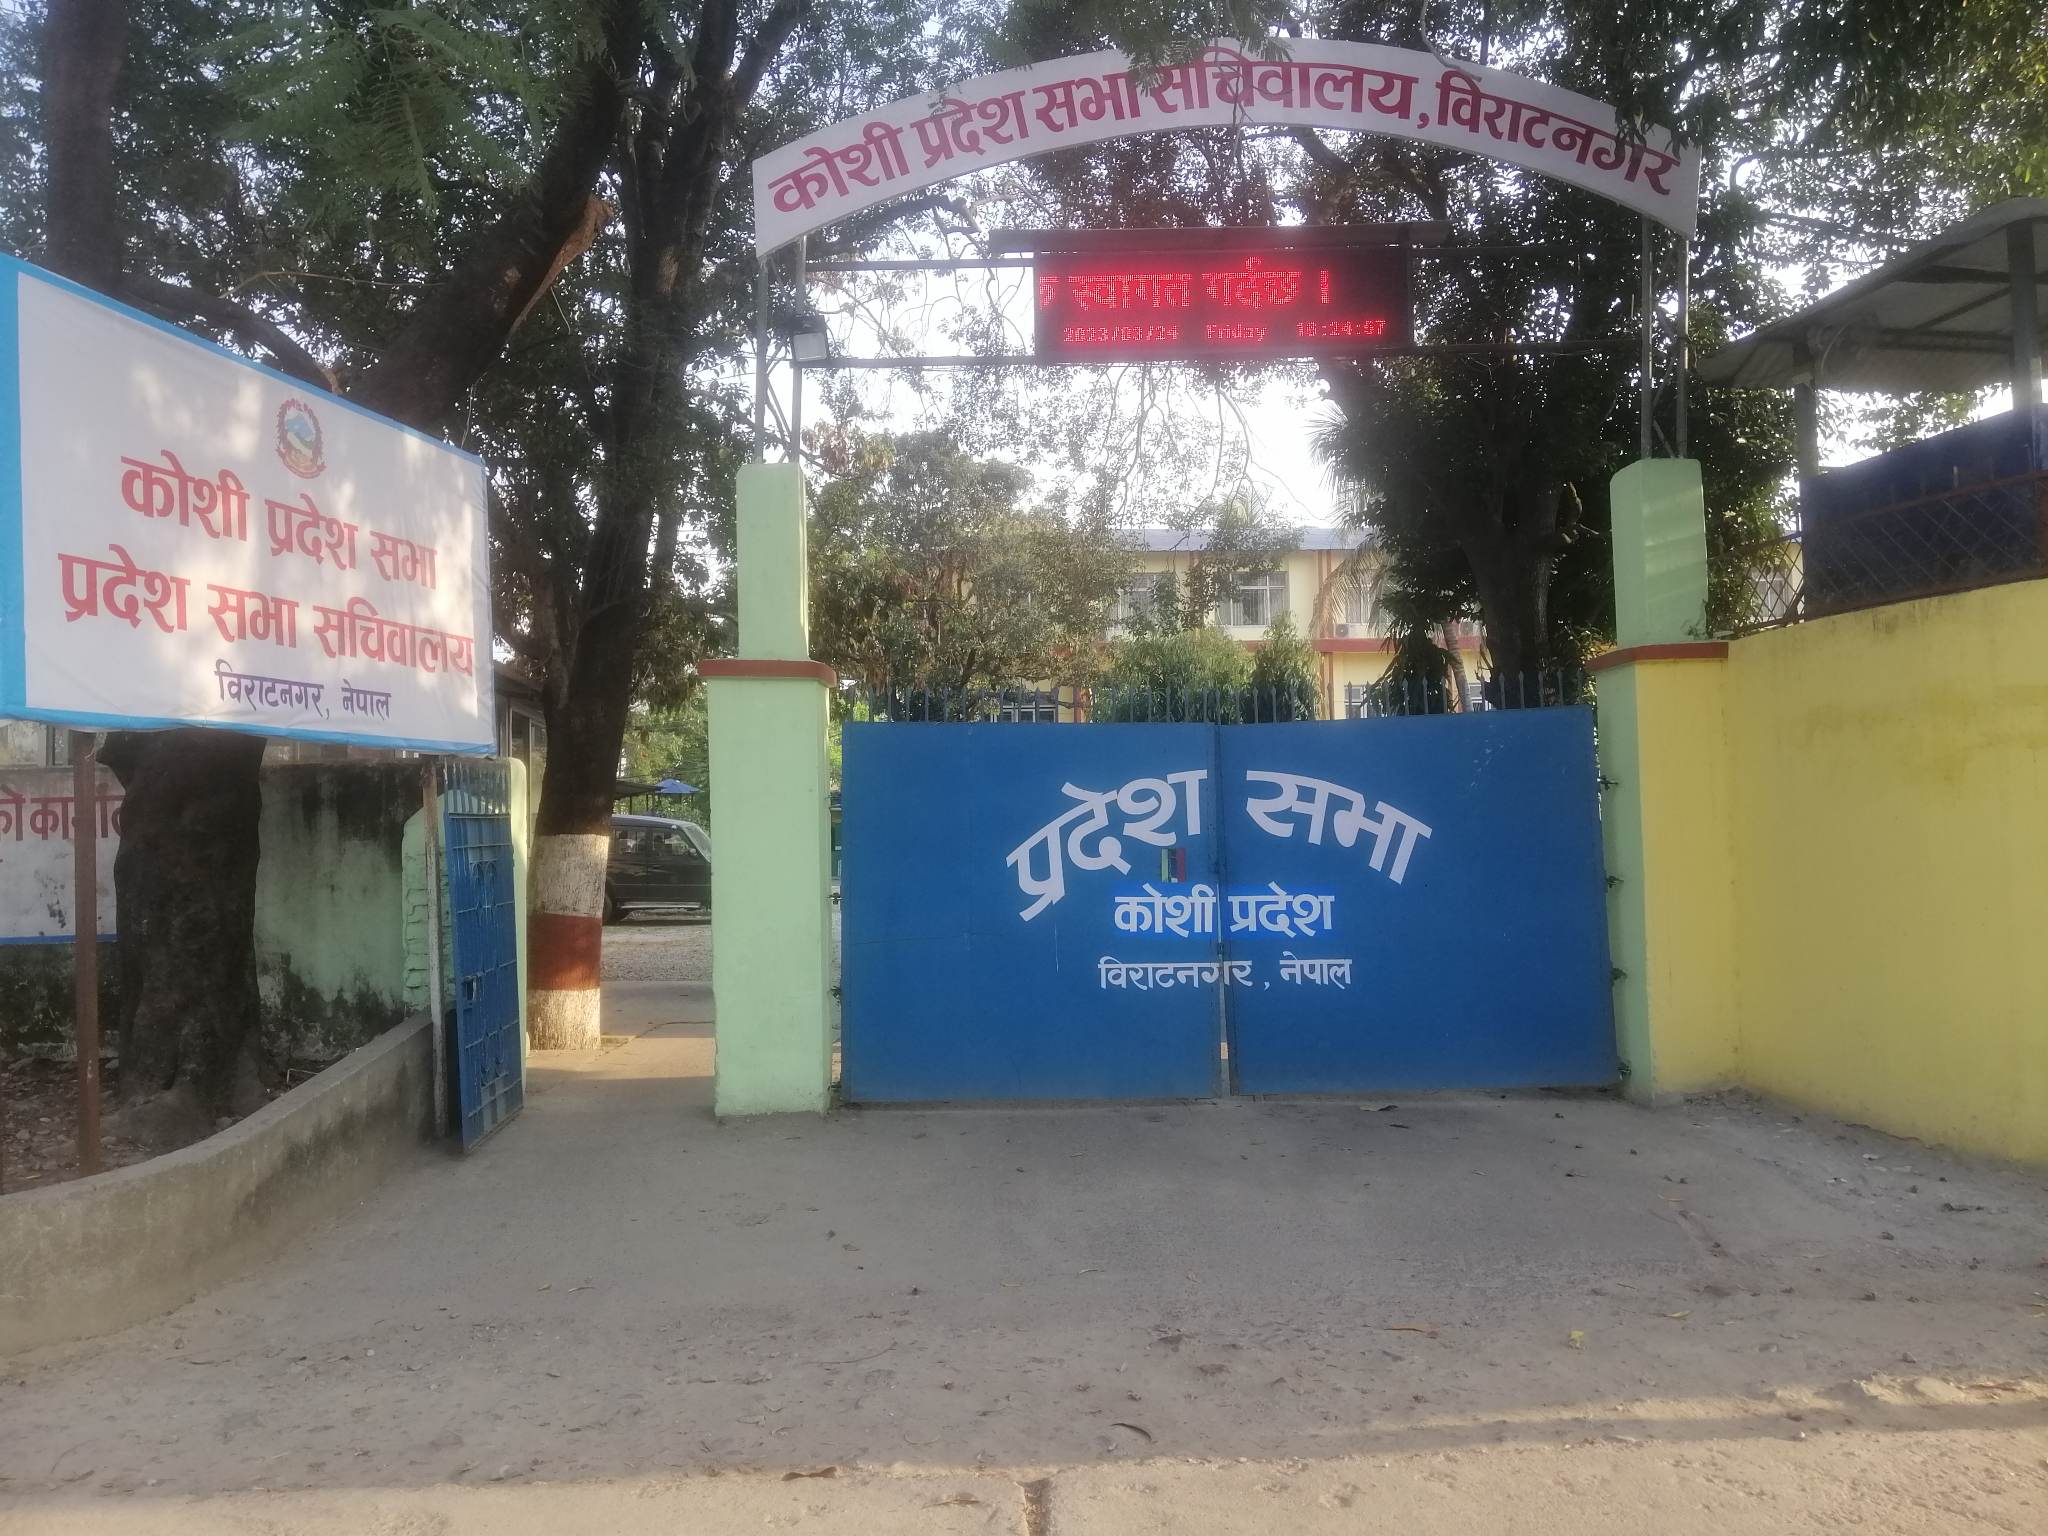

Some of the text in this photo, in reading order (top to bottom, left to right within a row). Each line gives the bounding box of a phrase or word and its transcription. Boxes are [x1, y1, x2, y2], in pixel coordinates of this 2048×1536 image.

[768, 121, 912, 215] कोशी
[911, 91, 1030, 169] प्रदेश
[1032, 71, 1142, 133] सभा
[1068, 272, 1193, 311] स्वागत
[1202, 256, 1302, 309] गर्दछ
[1063, 323, 1180, 343] 2023/03/24
[1206, 323, 1268, 342] Friday
[120, 449, 438, 589] कोशी प्रदेश सभा
[57, 544, 474, 677] प्रदेश सभा सचिवालय
[213, 659, 392, 720] विराटनगर, नेपाल
[1006, 769, 1433, 922] प्रदेश सभा
[1114, 881, 1335, 937] कोशी प्रदेश
[1280, 951, 1352, 989] नेपाल
